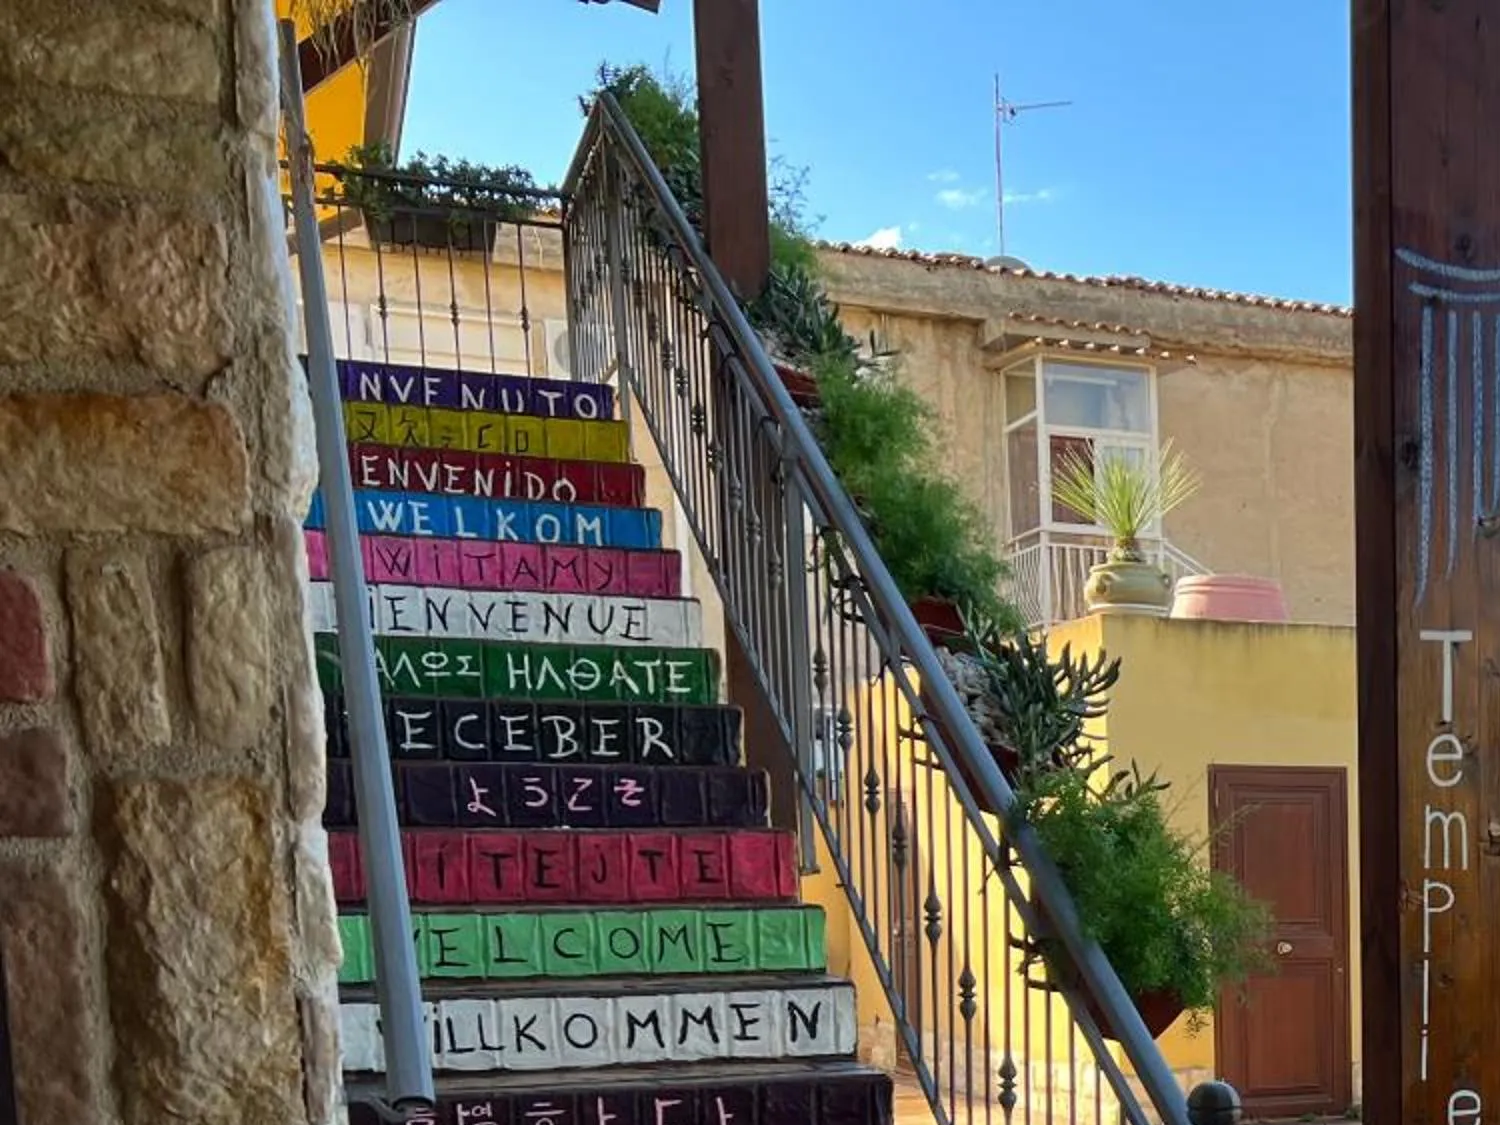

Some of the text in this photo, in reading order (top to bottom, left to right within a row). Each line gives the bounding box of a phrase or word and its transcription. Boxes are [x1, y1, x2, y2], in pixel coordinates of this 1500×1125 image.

[359, 371, 599, 420] NVENUTO
[367, 499, 604, 547] WELKOM
[395, 710, 676, 760] ECEBER
[437, 840, 724, 891] ÍTEJTE
[413, 921, 737, 968] ELCOME
